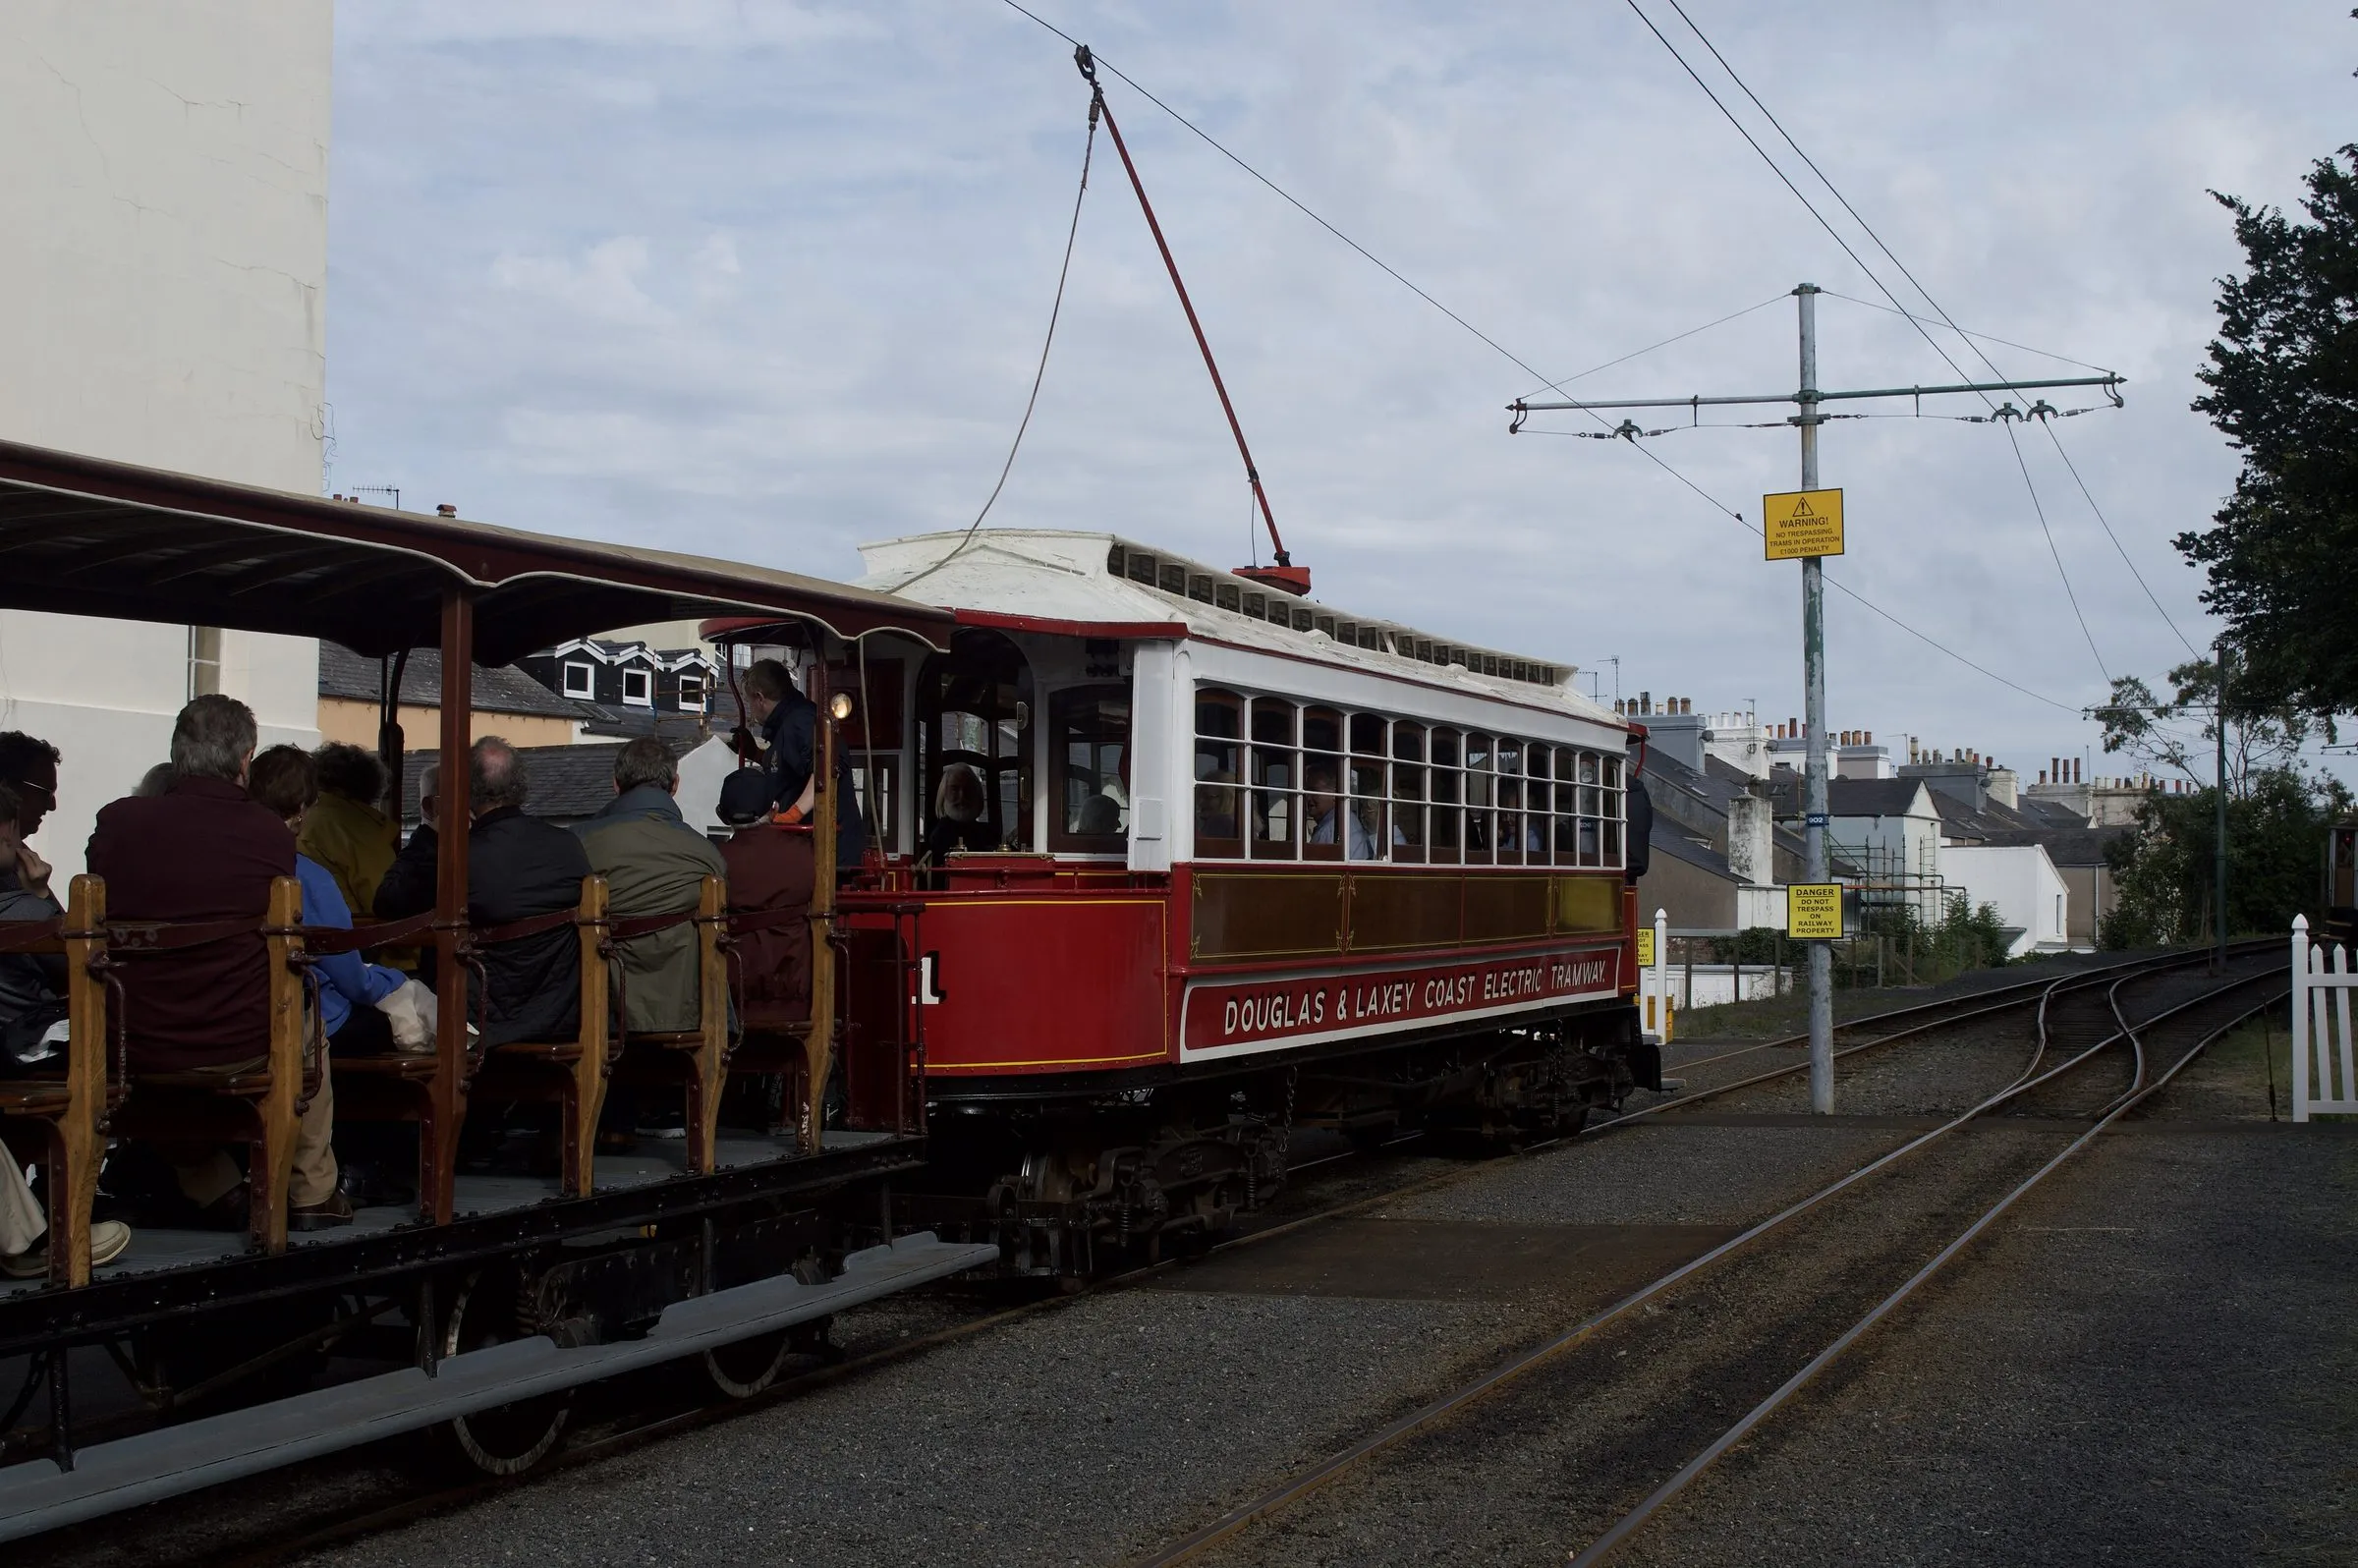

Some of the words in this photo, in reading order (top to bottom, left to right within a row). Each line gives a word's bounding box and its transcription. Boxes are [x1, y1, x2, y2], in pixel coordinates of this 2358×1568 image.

[1779, 517, 1828, 529] WARNING!
[1788, 529, 1832, 537] TRESPASSING
[1224, 990, 1325, 1036] DOUGLAS
[1336, 989, 1347, 1021] &
[1355, 982, 1416, 1018] LAXEY
[1425, 976, 1476, 1009] COAST
[1484, 968, 1543, 1000] ELECTRIC
[1550, 960, 1606, 989] TRAMWAY.
